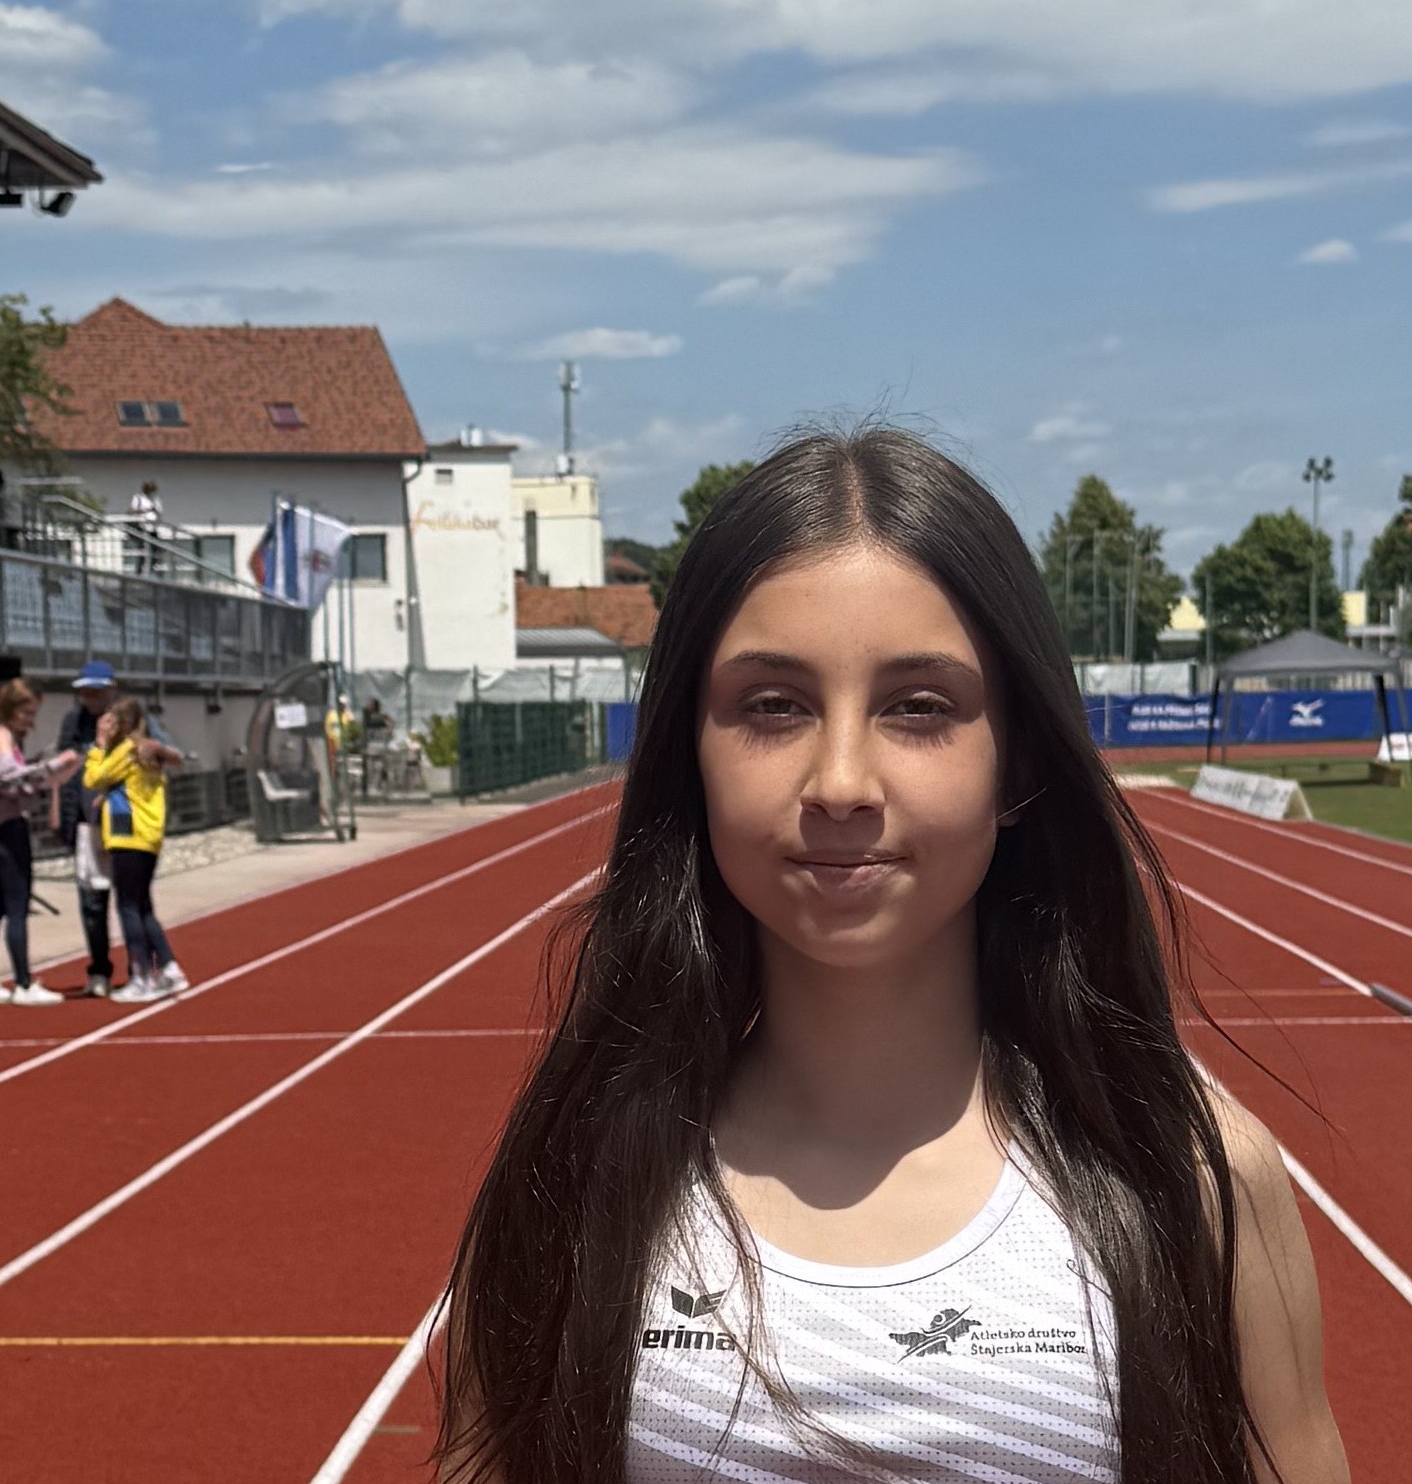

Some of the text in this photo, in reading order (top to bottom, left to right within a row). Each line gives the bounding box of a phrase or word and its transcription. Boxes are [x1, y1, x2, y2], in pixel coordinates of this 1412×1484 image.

[642, 1325, 737, 1351] erima
[971, 1328, 1076, 1341] Atletsko društvo
